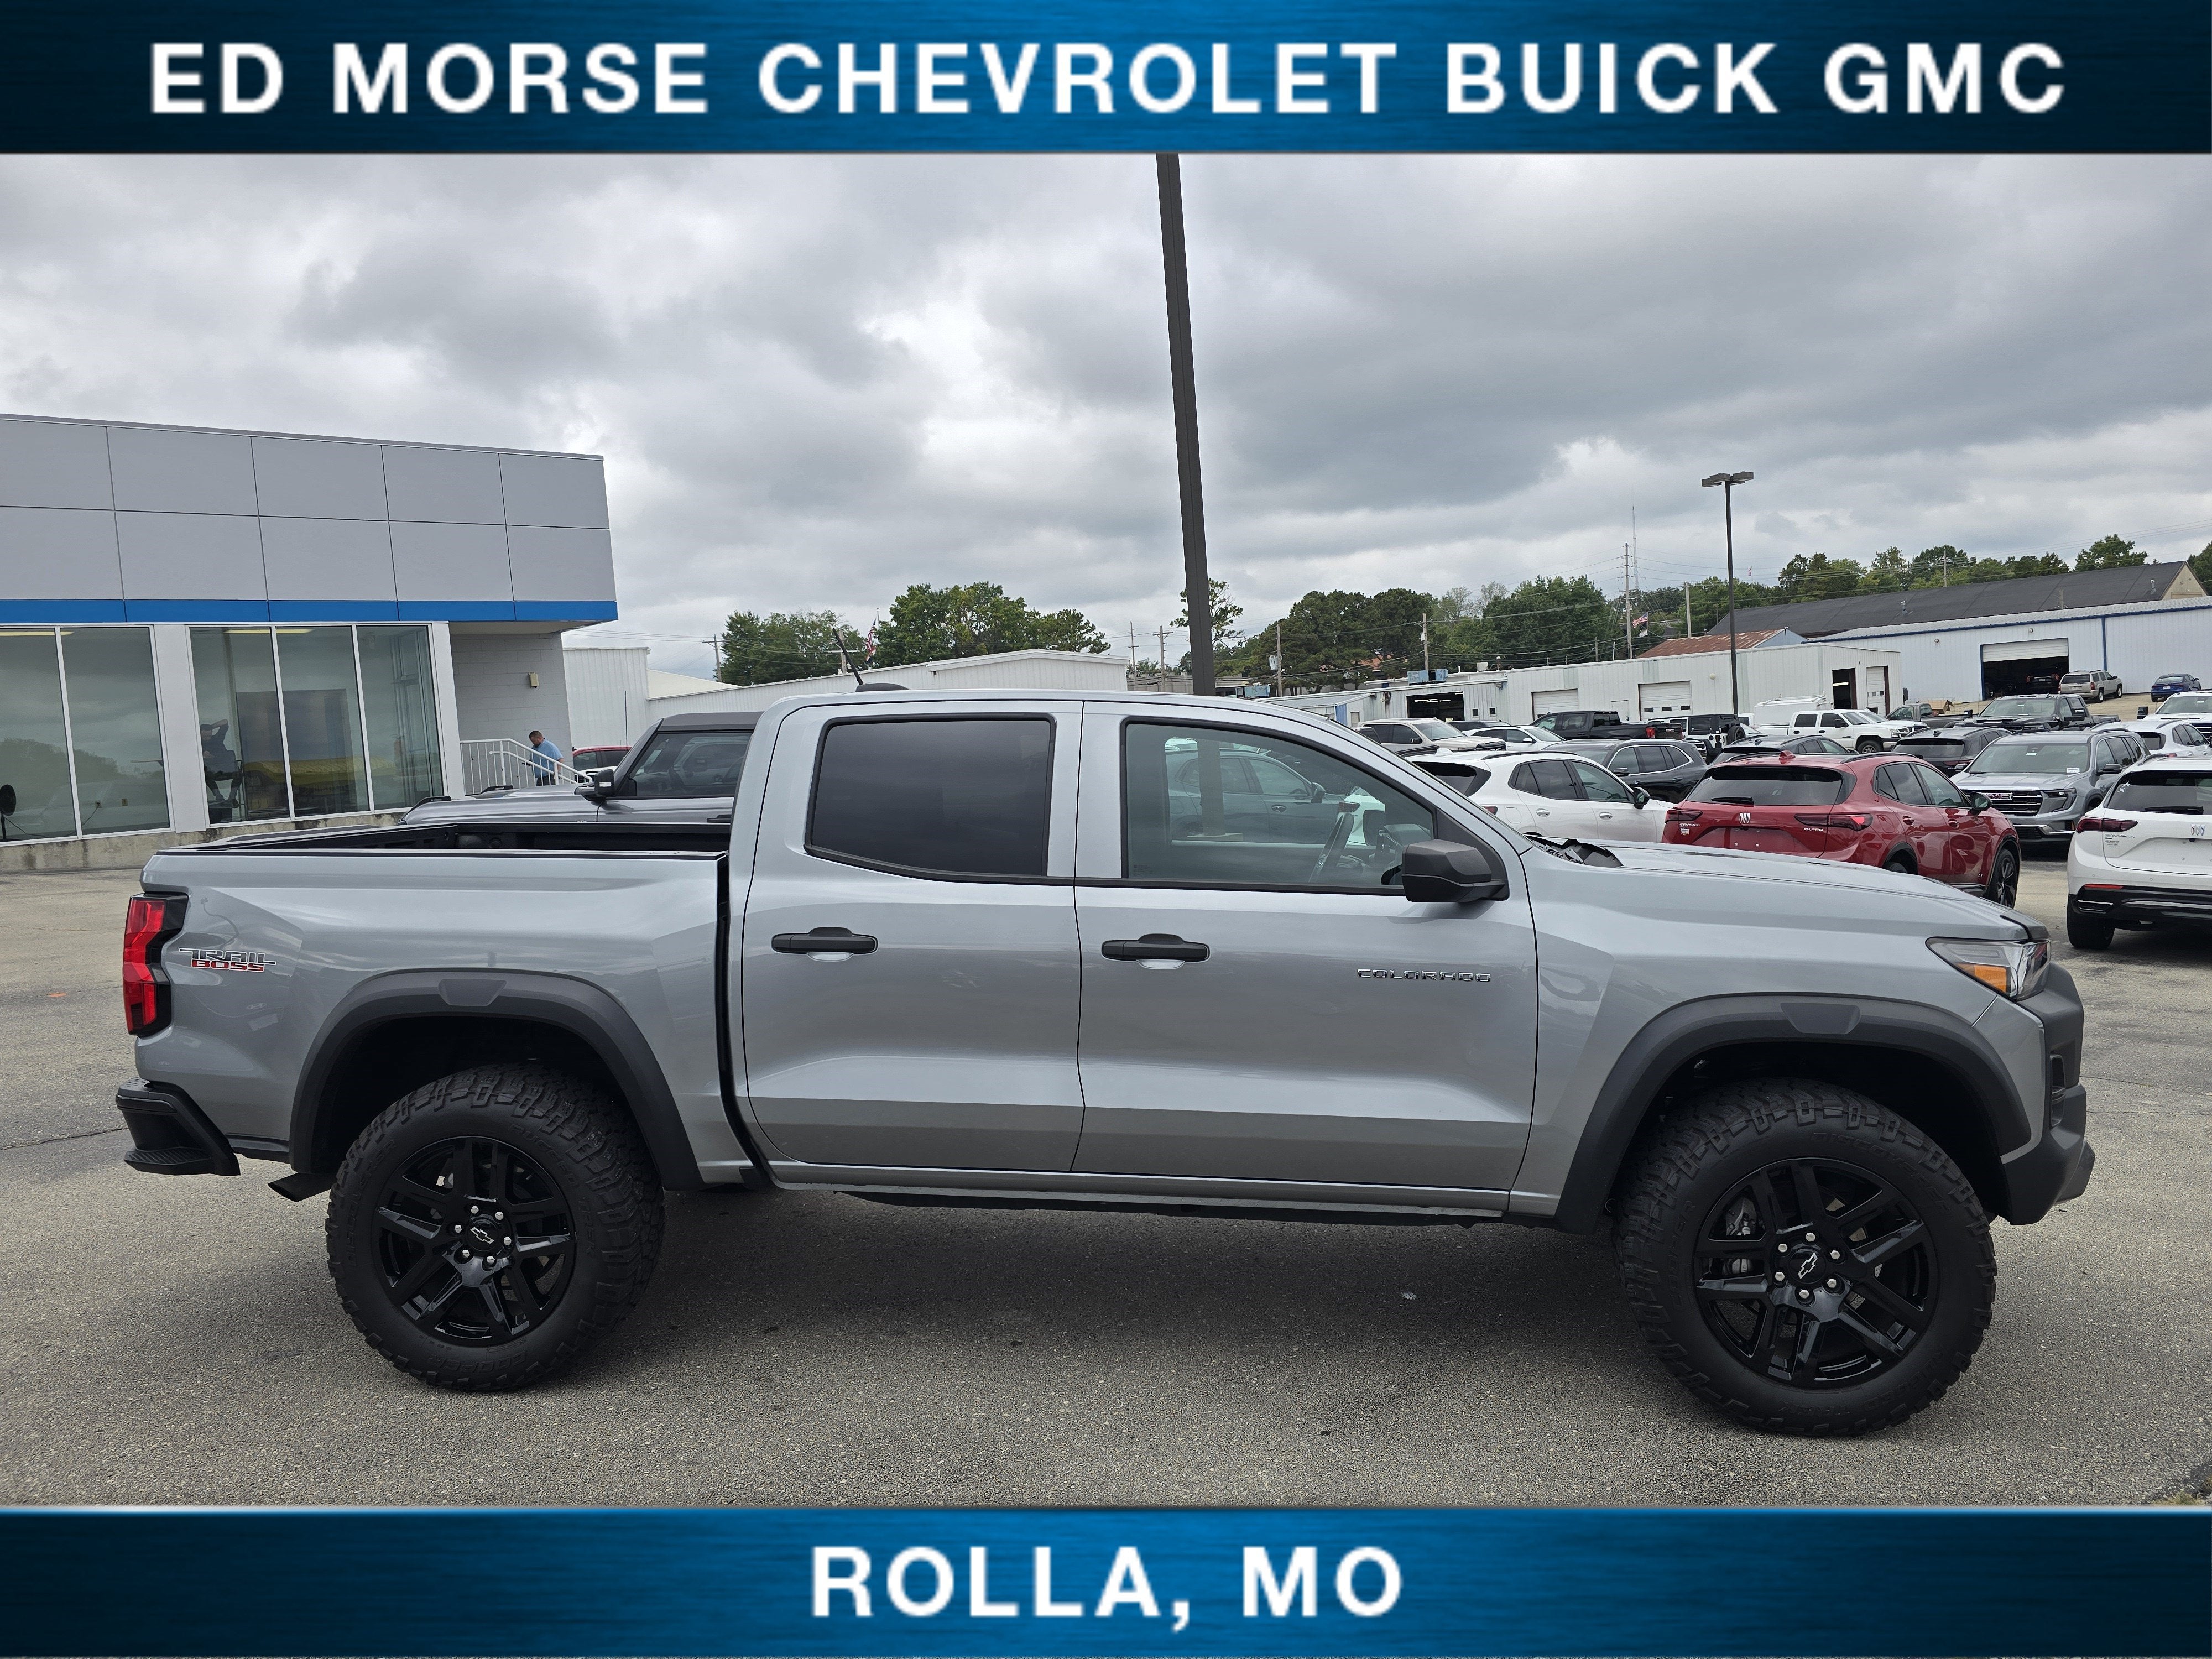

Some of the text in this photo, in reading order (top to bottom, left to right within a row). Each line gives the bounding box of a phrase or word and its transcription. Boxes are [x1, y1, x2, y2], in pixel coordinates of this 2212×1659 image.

[179, 948, 276, 966] TRAIL
[190, 959, 265, 972] BOSS
[1357, 969, 1492, 982] COLORADO
[509, 1123, 580, 1188] RUGGED
[1809, 1131, 1952, 1215] DISCOVERER
